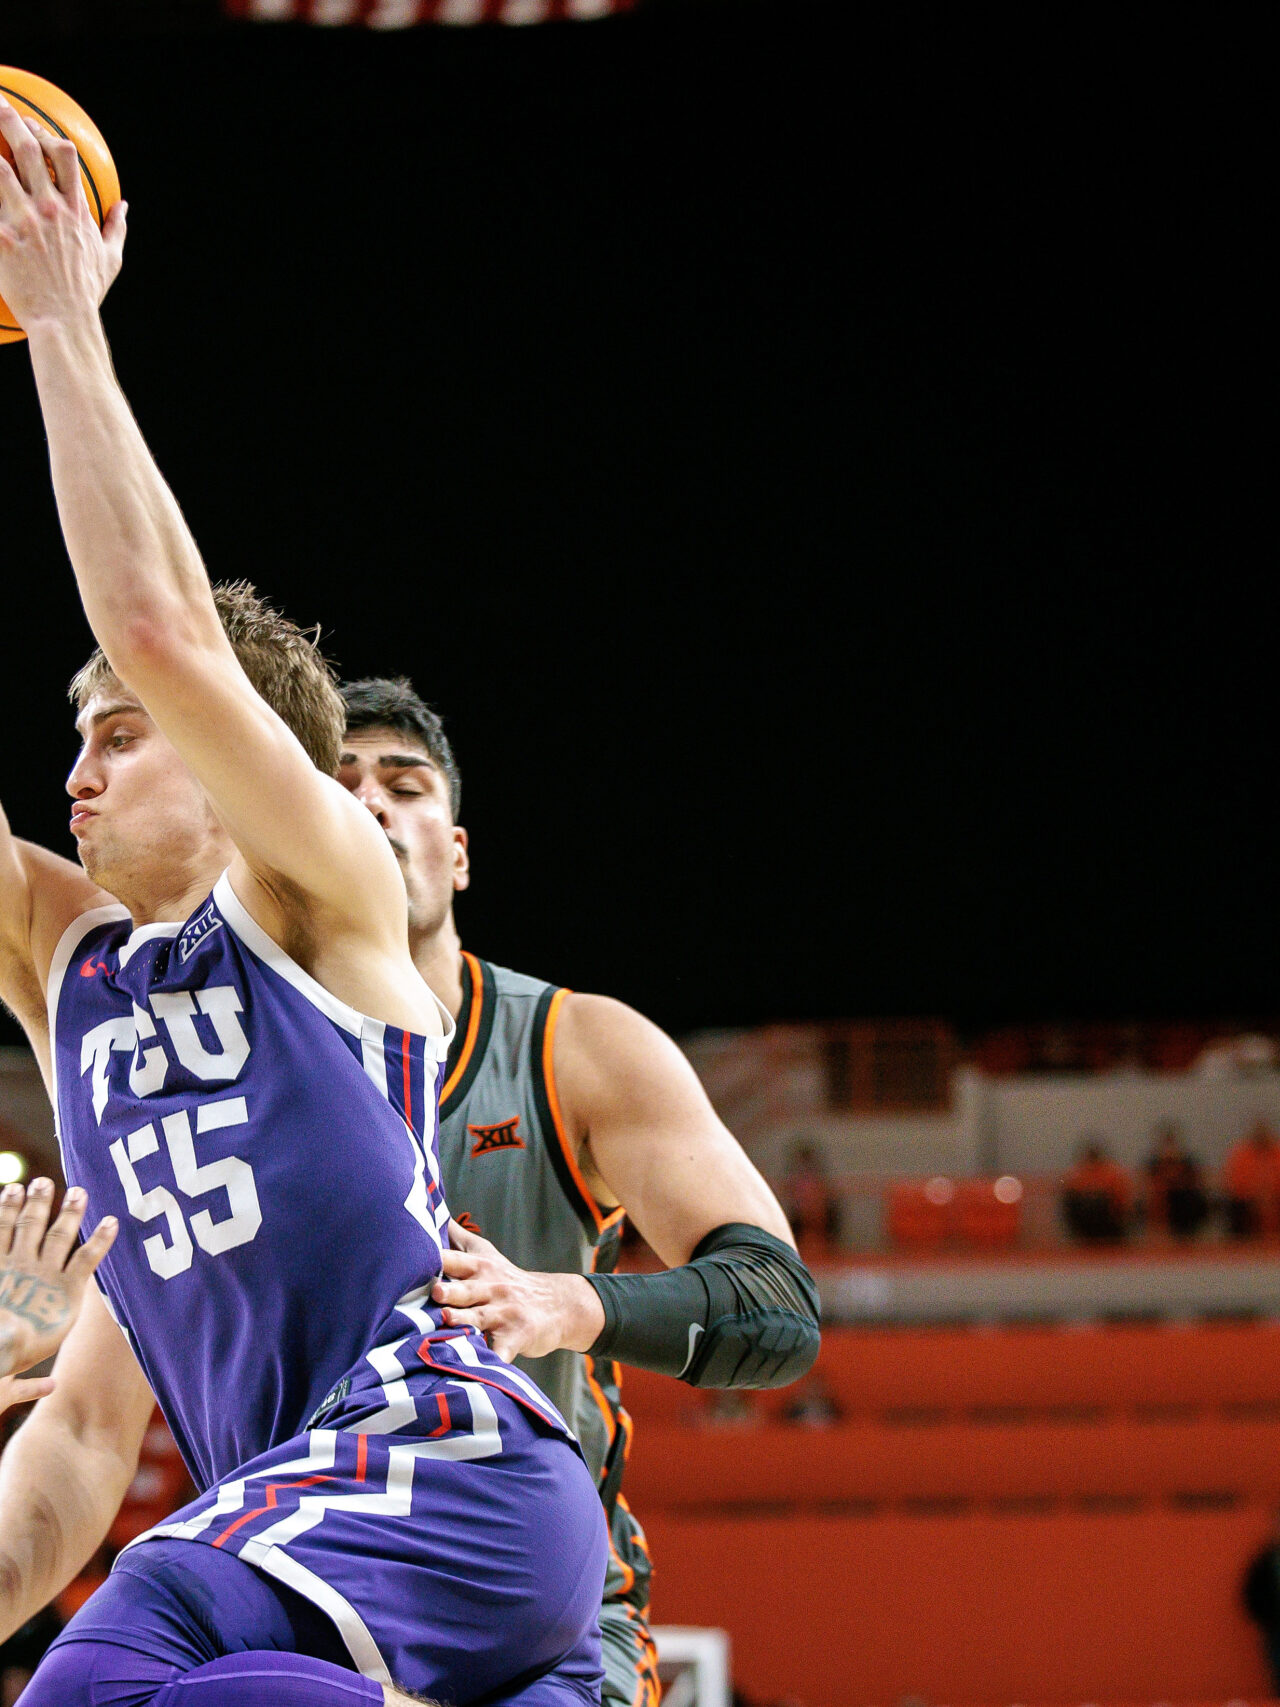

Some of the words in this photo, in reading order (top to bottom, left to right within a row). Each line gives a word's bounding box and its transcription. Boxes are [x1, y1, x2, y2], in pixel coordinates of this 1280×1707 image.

[80, 986, 251, 1127] TCU
[109, 1096, 263, 1280] 55
[469, 1117, 524, 1156] XII
